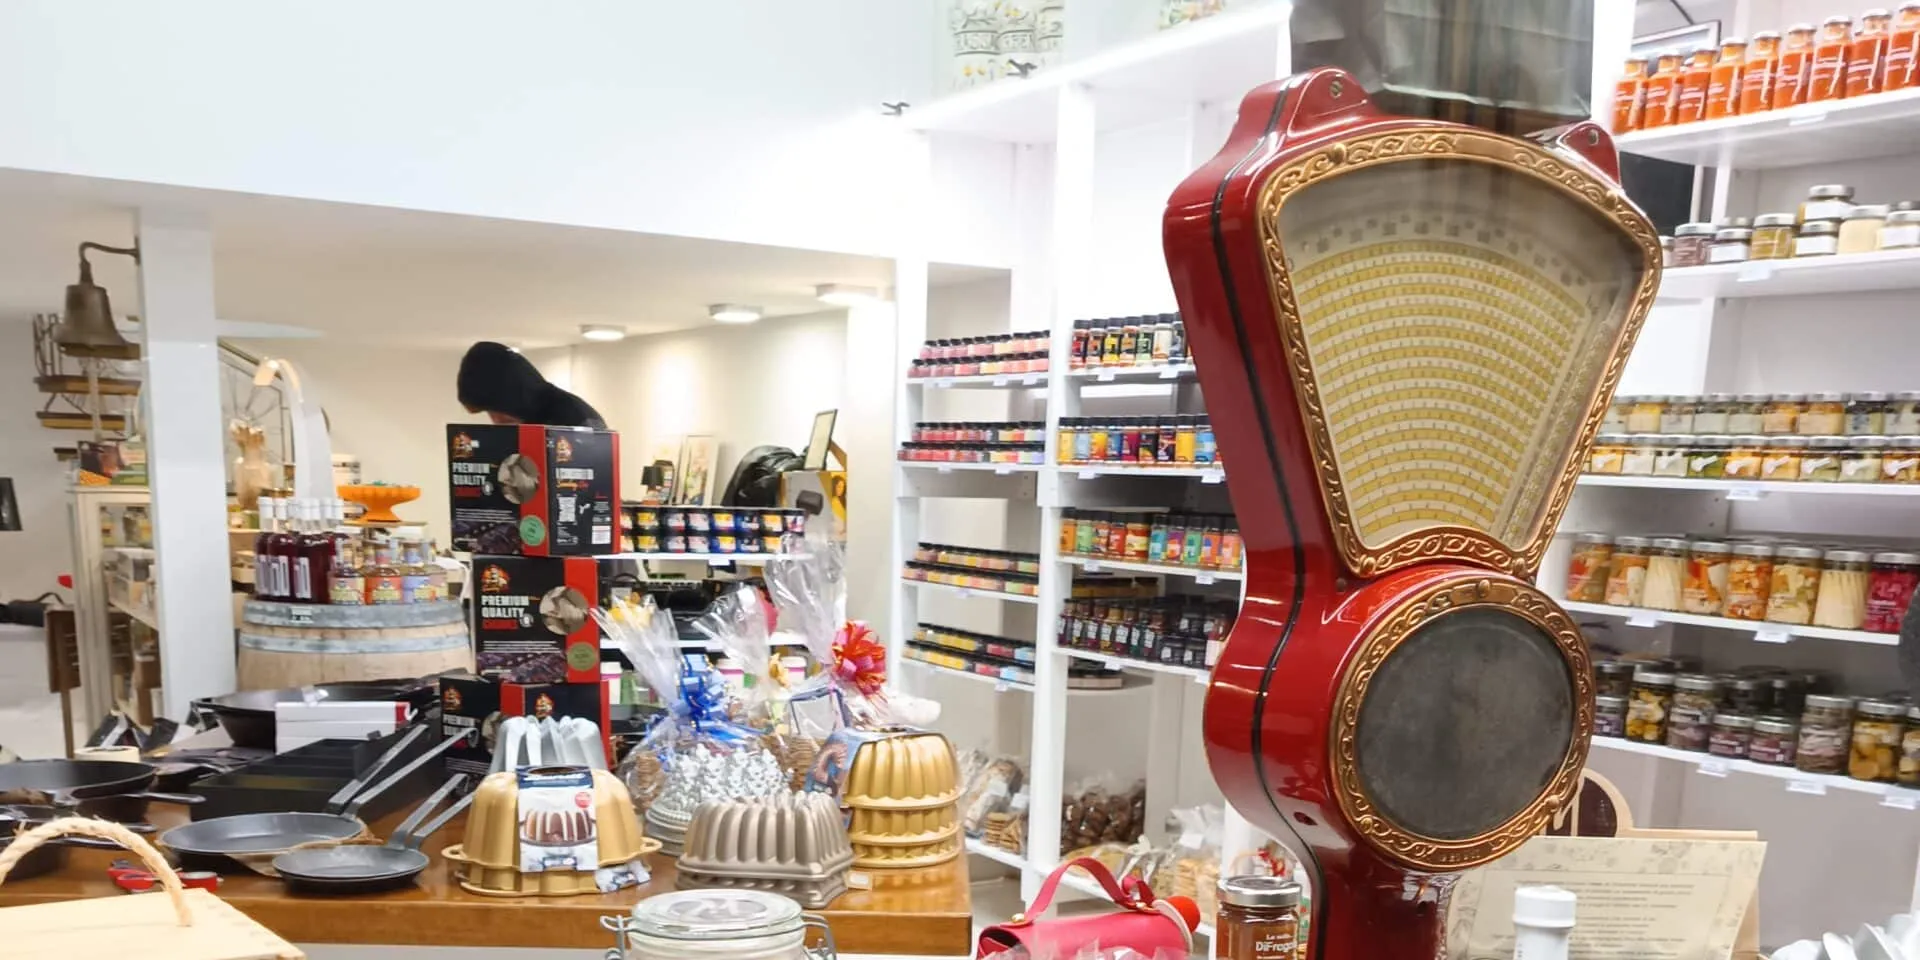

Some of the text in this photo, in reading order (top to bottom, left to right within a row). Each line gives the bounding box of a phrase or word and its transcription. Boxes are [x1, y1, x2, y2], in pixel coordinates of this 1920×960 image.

[452, 462, 491, 474] PREMIUM
[453, 474, 487, 486] QUALITY
[481, 595, 530, 606] PREMIUM
[481, 607, 525, 618] QUALITY
